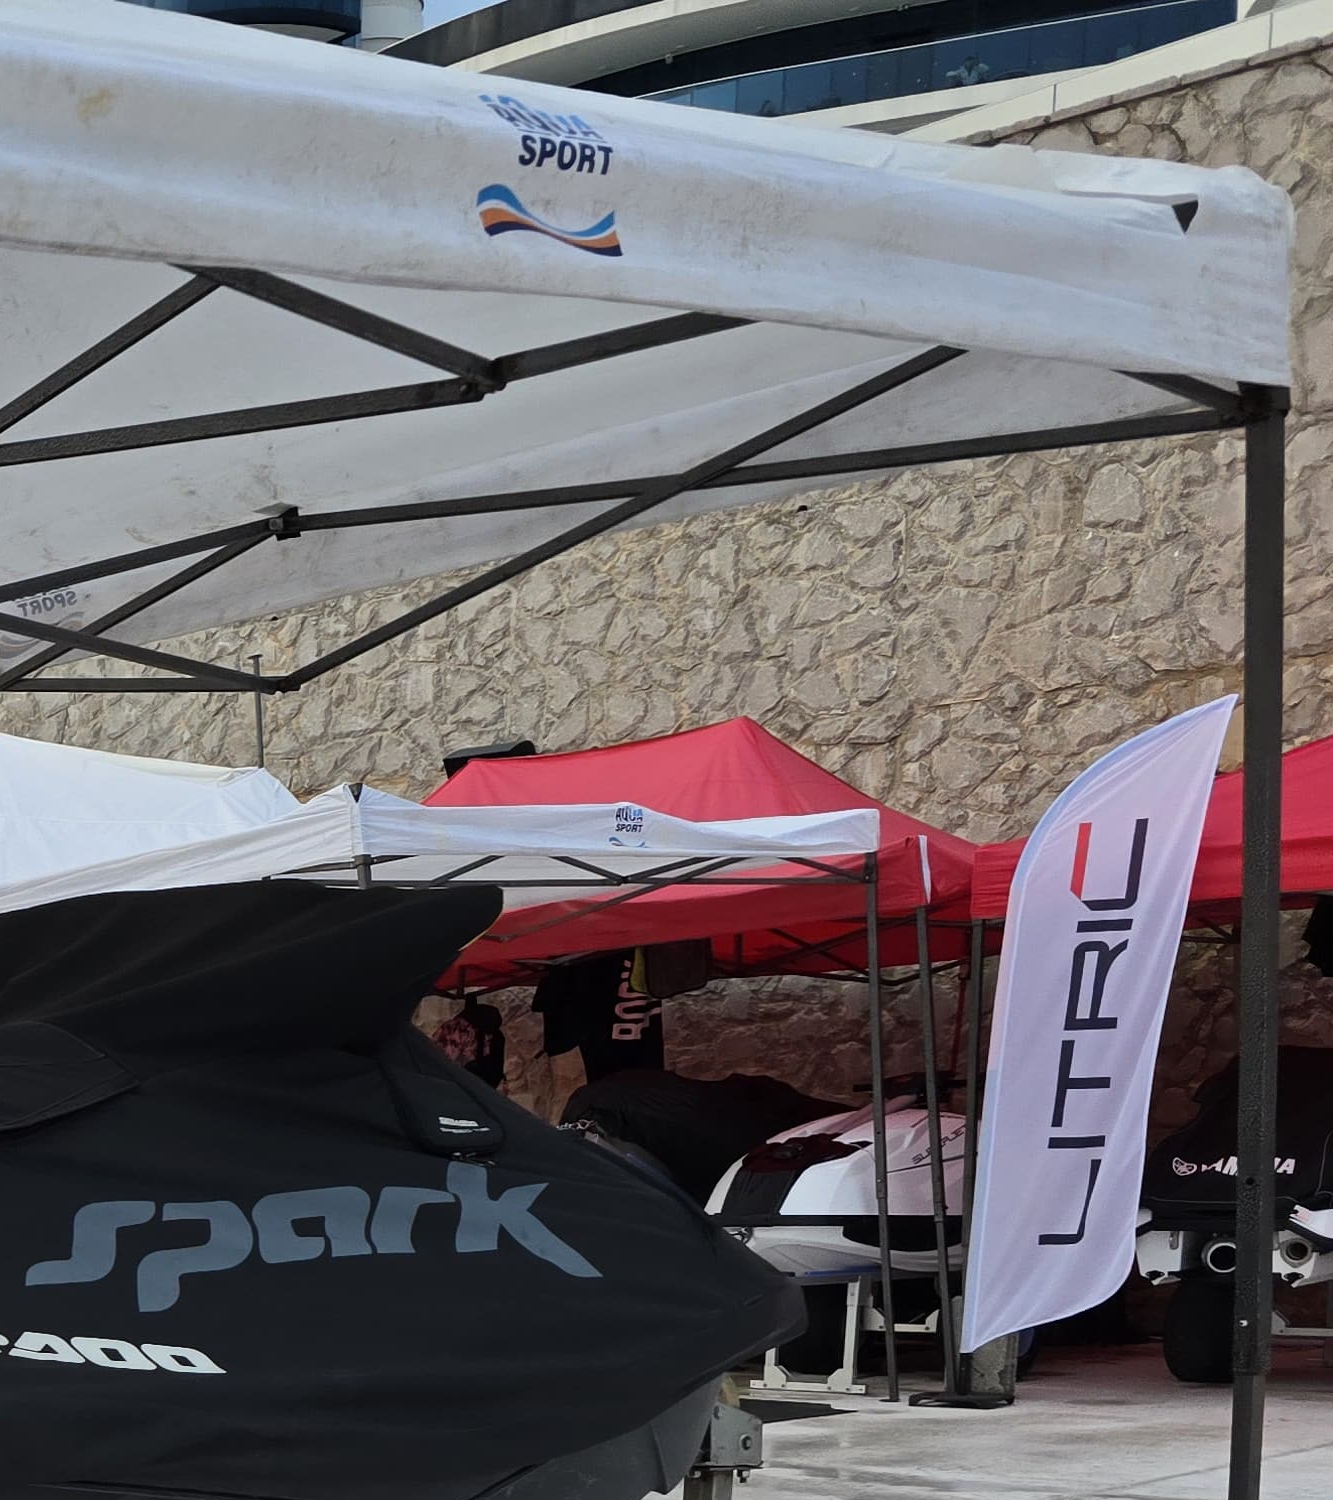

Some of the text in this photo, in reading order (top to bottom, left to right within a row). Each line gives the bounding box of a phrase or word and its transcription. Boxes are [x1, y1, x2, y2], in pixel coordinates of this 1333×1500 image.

[518, 134, 613, 175] SPORT
[615, 805, 643, 822] AQUA
[615, 823, 643, 832] SPORT
